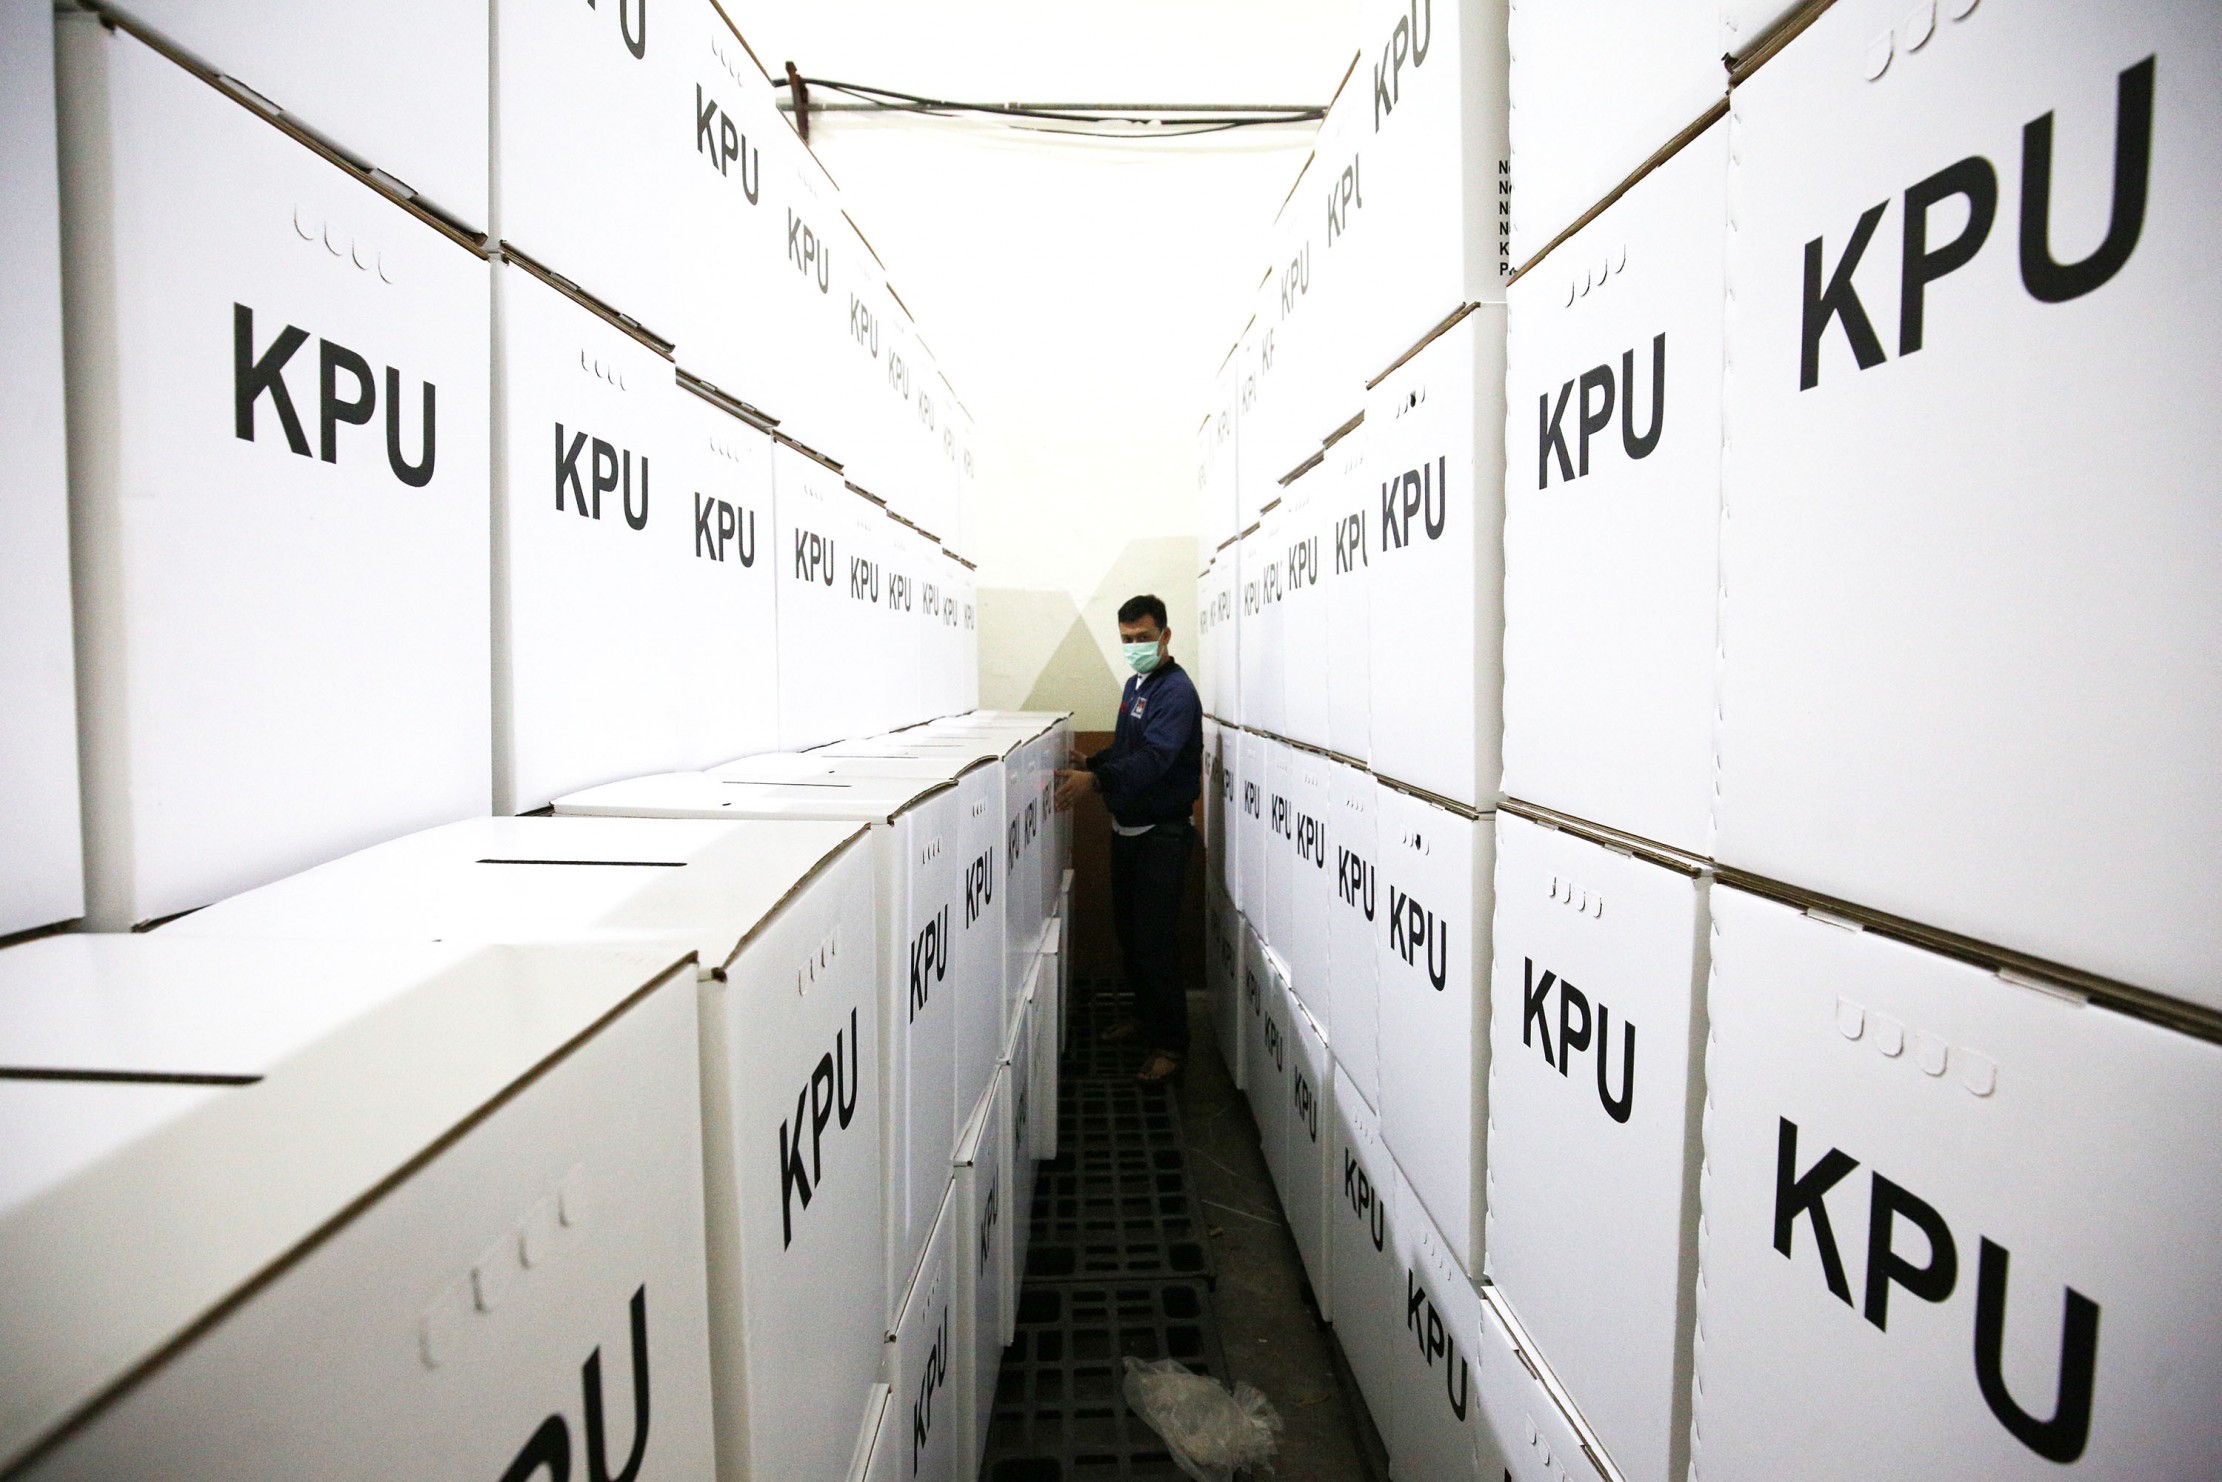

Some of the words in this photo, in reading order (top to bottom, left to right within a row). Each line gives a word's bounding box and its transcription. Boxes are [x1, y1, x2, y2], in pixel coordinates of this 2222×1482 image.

[1374, 0, 1430, 135] KPU
[696, 82, 759, 206] KPU
[788, 206, 828, 294] KPU
[1801, 54, 2156, 391] KPU
[1282, 240, 1309, 321] KPU
[850, 291, 878, 358] KPU
[234, 300, 437, 488] KPU
[889, 346, 909, 400] KPU
[918, 387, 934, 431] KPU
[1540, 333, 1666, 490] KPU
[555, 420, 648, 532] KPU
[1382, 455, 1446, 552] KPU
[694, 492, 755, 568] KPU
[795, 528, 833, 586] KPU
[1289, 536, 1317, 591] KPU
[851, 556, 878, 603] KPU
[889, 573, 911, 612] KPU
[922, 583, 939, 616] KPU
[943, 597, 957, 627] KPU
[1217, 588, 1231, 622] KPU
[1244, 579, 1260, 616] KPU
[1264, 560, 1282, 606] KPU
[1024, 797, 1037, 850] KPU
[1222, 768, 1234, 802] PU
[1244, 778, 1260, 820] KPU
[1271, 793, 1292, 841] KPU
[1008, 812, 1020, 877] KPU
[1297, 812, 1325, 868] KPU
[966, 846, 992, 929] KPU
[1339, 846, 1375, 923] KPU
[910, 904, 948, 1025] KPU
[1389, 883, 1447, 993] KPU
[1264, 1016, 1283, 1073] KPU
[1523, 956, 1636, 1124] KPU
[780, 1008, 858, 1250] KPU
[1294, 1065, 1317, 1143] KPU
[981, 1164, 998, 1278] KPU
[1344, 1147, 1384, 1253] KPU
[1776, 1115, 2100, 1465] KPU
[1407, 1268, 1468, 1422] KPU
[914, 1304, 948, 1478] KPU
